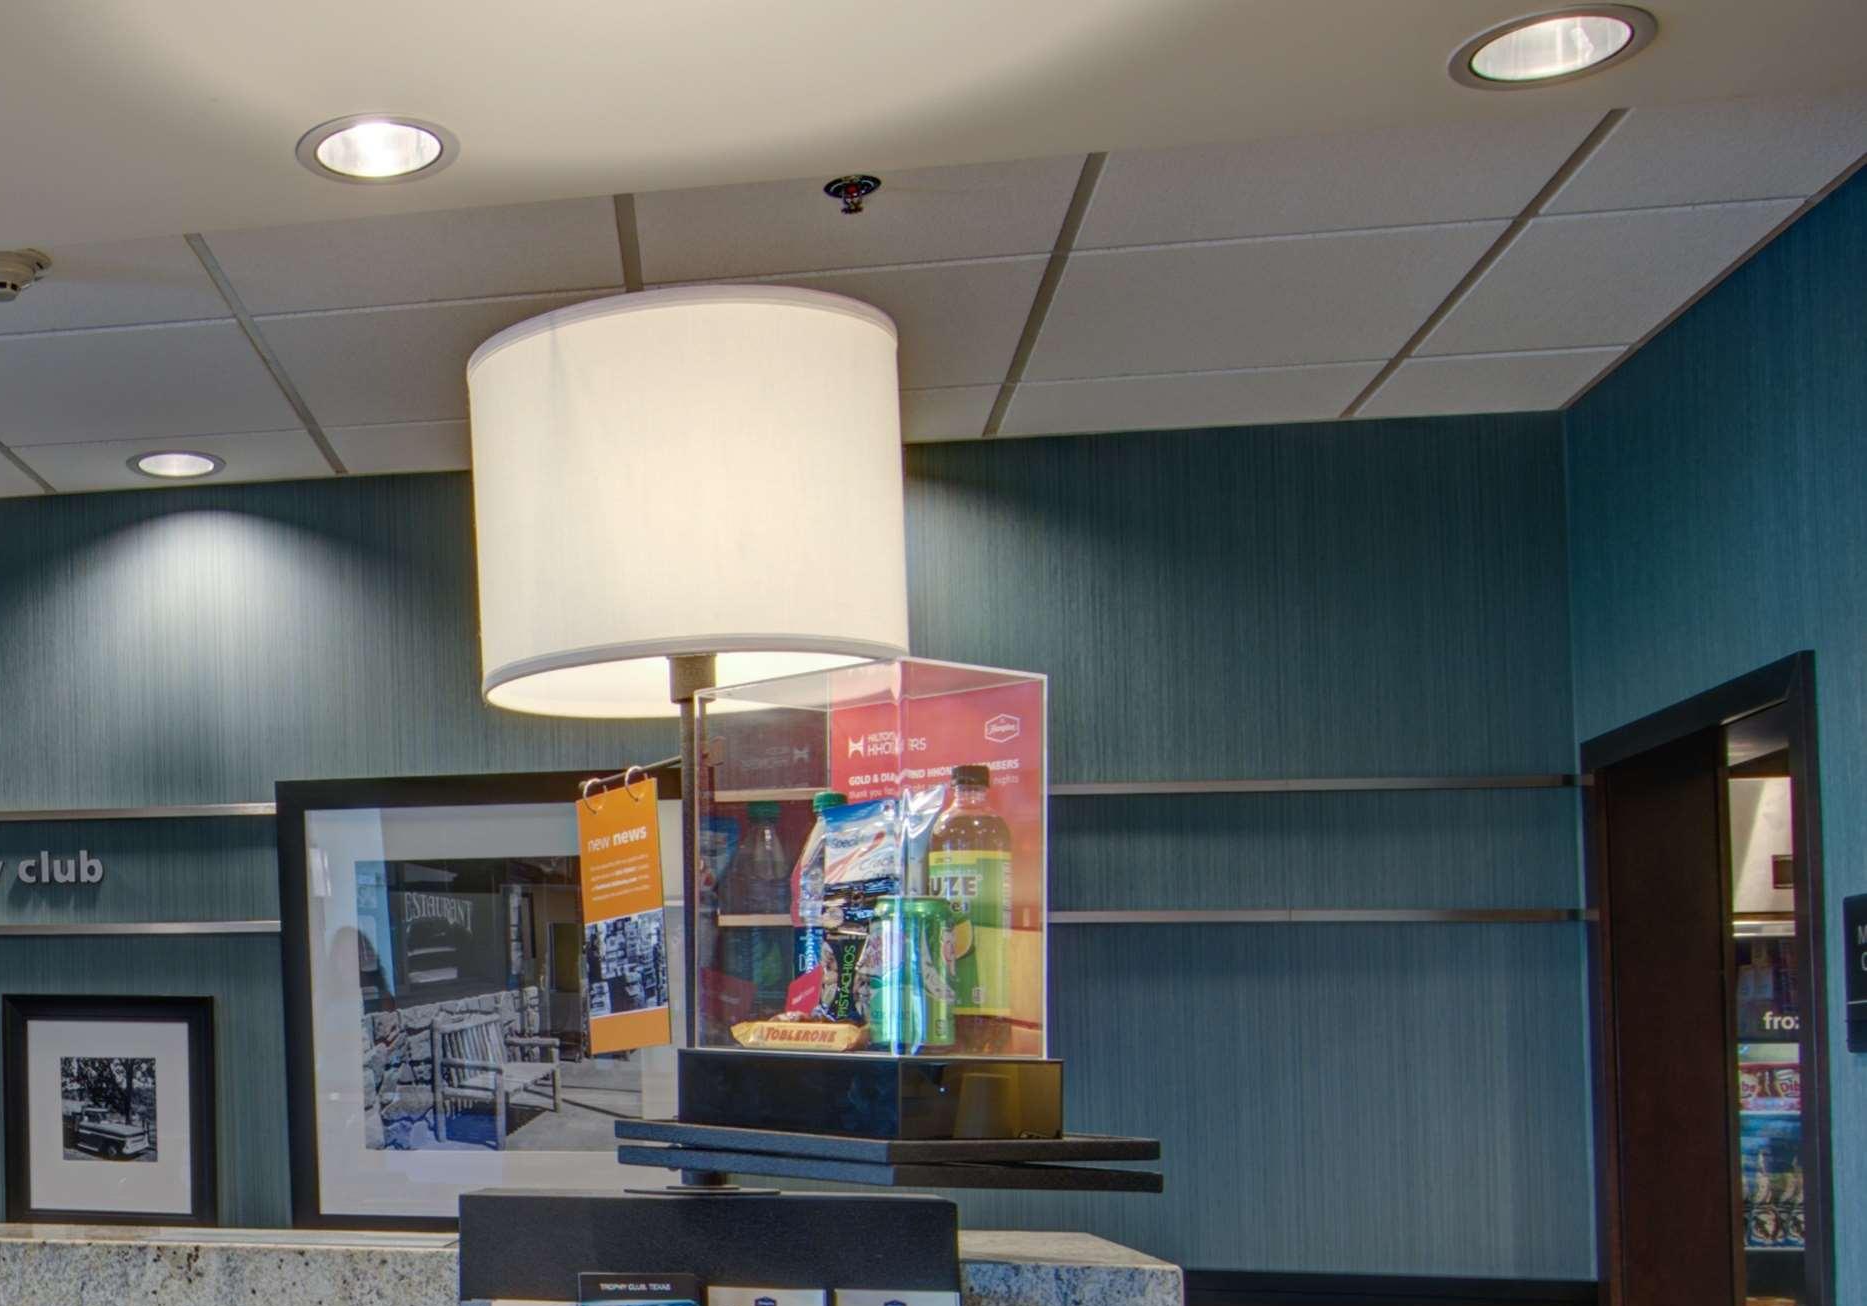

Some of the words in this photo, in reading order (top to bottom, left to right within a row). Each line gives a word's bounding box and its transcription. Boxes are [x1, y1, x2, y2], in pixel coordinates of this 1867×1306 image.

[848, 775, 870, 786] GOLD
[588, 836, 610, 852] new
[613, 826, 647, 846] news
[17, 850, 104, 884] club
[836, 944, 855, 1019] PISTACHIOS
[1763, 1010, 1799, 1030] fro
[763, 1025, 838, 1042] TOBLERONE
